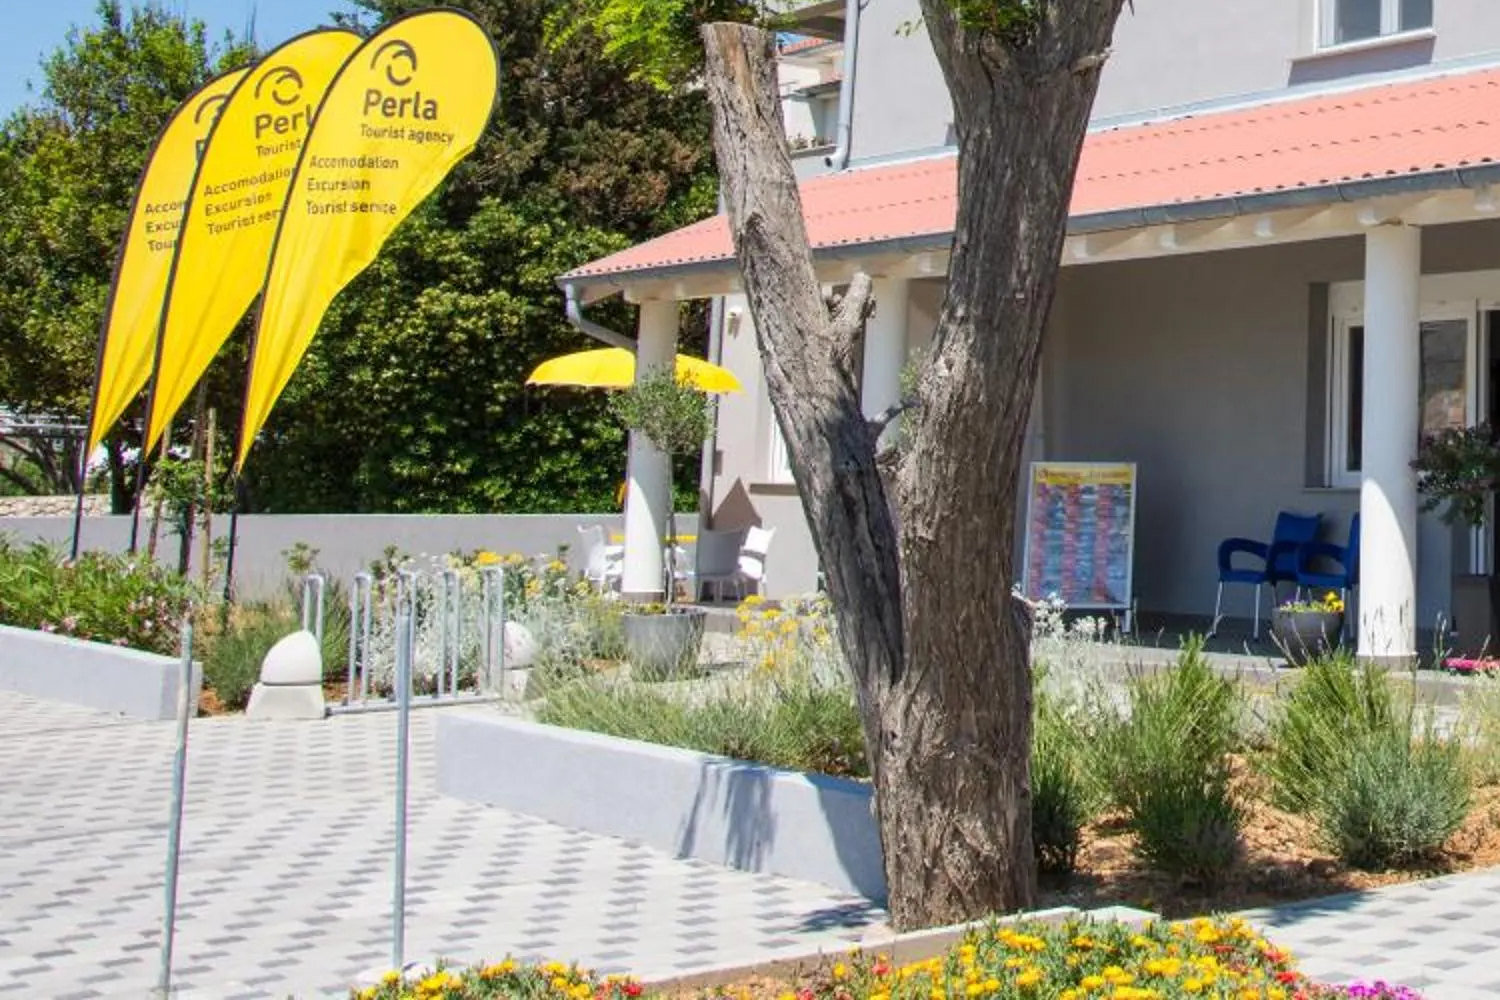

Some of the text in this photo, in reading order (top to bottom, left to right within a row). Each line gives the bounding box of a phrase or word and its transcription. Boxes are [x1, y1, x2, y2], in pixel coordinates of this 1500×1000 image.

[363, 88, 438, 120] Perla
[255, 104, 312, 139] Perl
[361, 124, 455, 146] Tourist agency
[256, 139, 301, 157] Tourist
[309, 155, 399, 169] Accomodation
[204, 167, 295, 197] Accomodatio
[307, 177, 371, 191] Excursion
[205, 192, 272, 216] Excursion
[306, 200, 397, 215] Tourist service
[207, 214, 256, 235] Tourist
